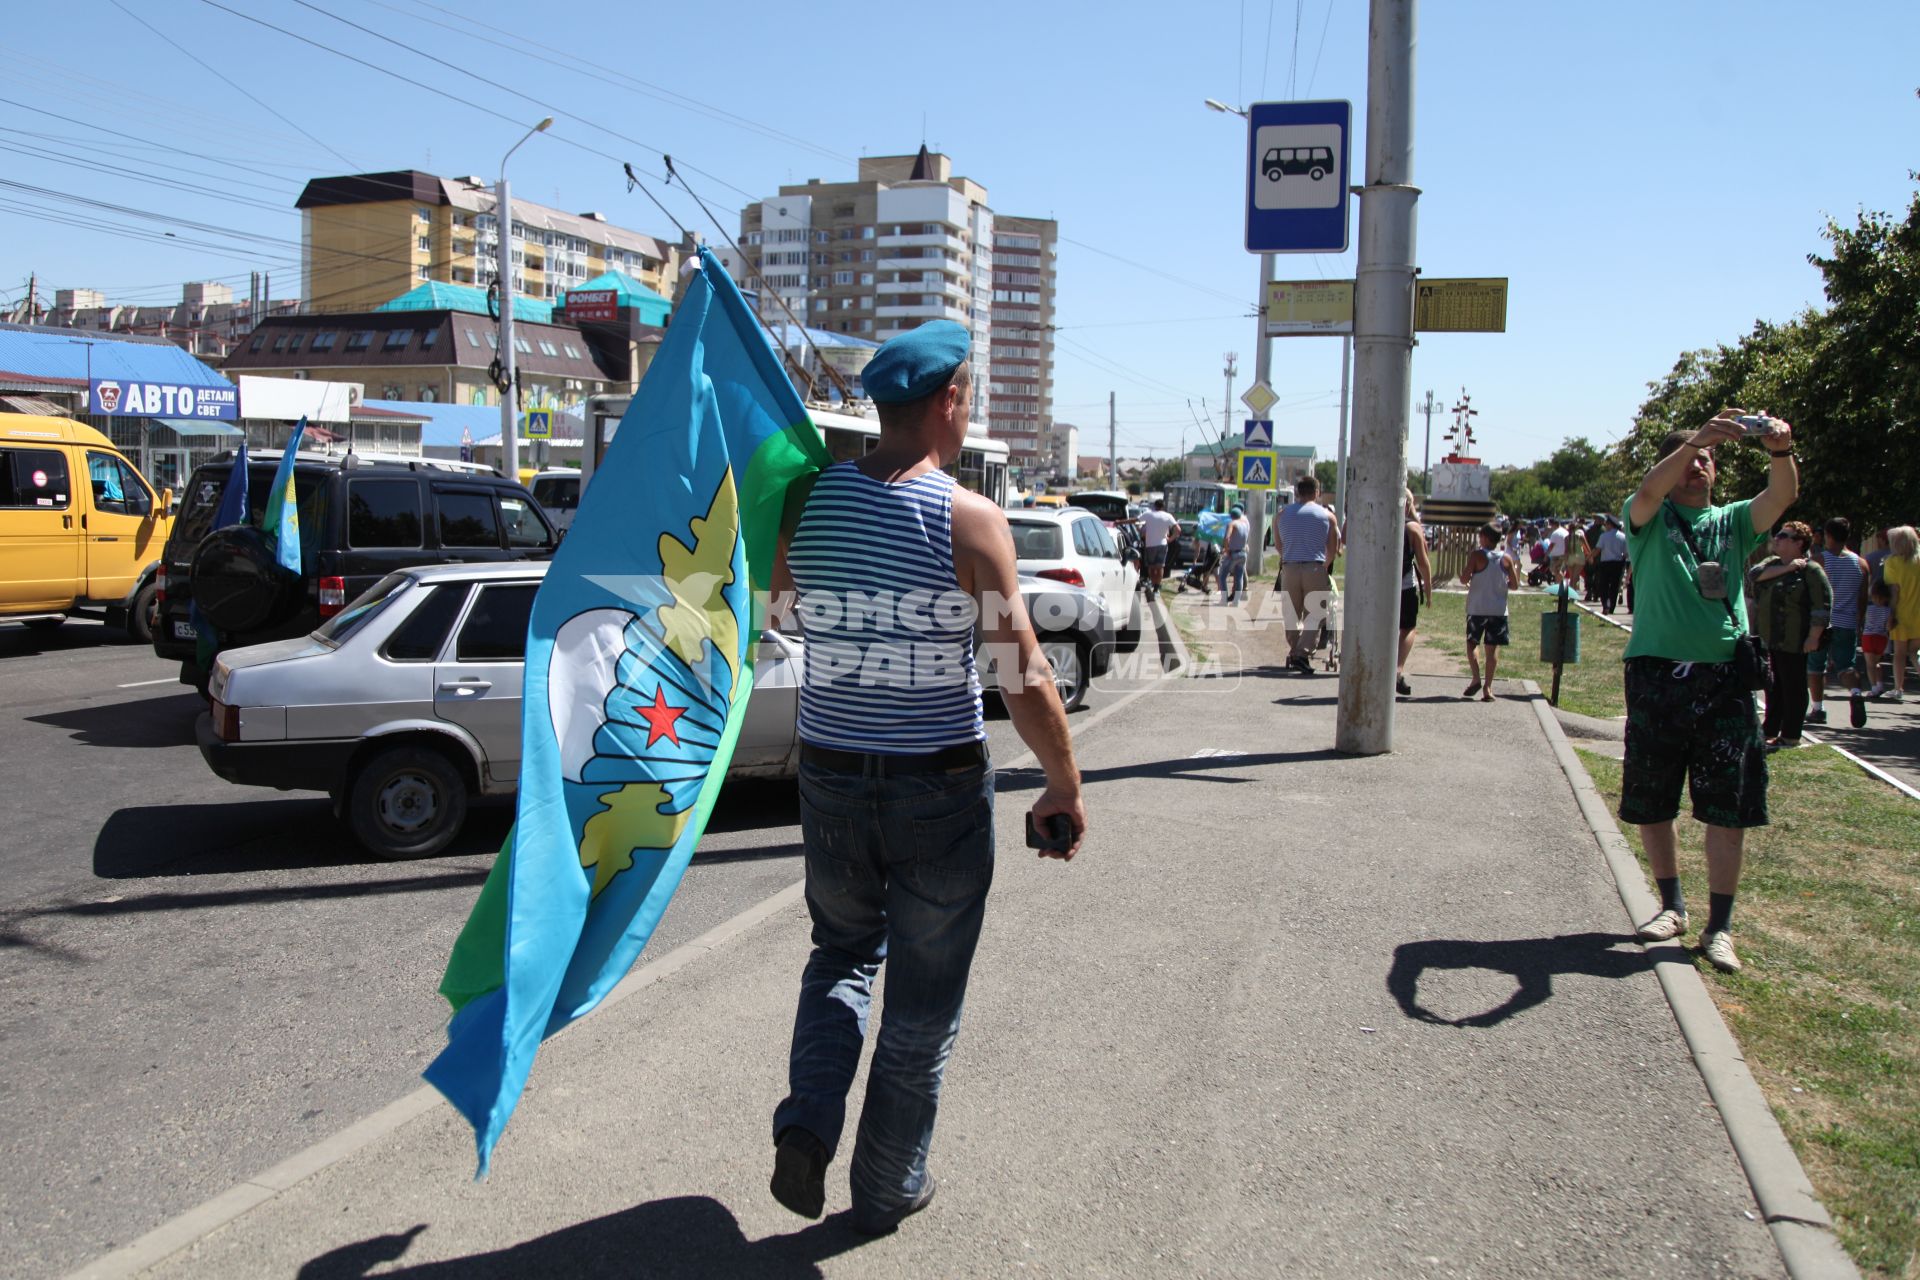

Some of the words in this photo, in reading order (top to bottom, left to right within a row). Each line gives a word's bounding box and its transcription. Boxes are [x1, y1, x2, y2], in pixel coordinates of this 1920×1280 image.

[568, 292, 613, 303] ФОНБЕТ
[124, 383, 194, 416] АВТО
[197, 389, 235, 403] ДЕТАЛИ
[197, 404, 221, 417] СВЕТ
